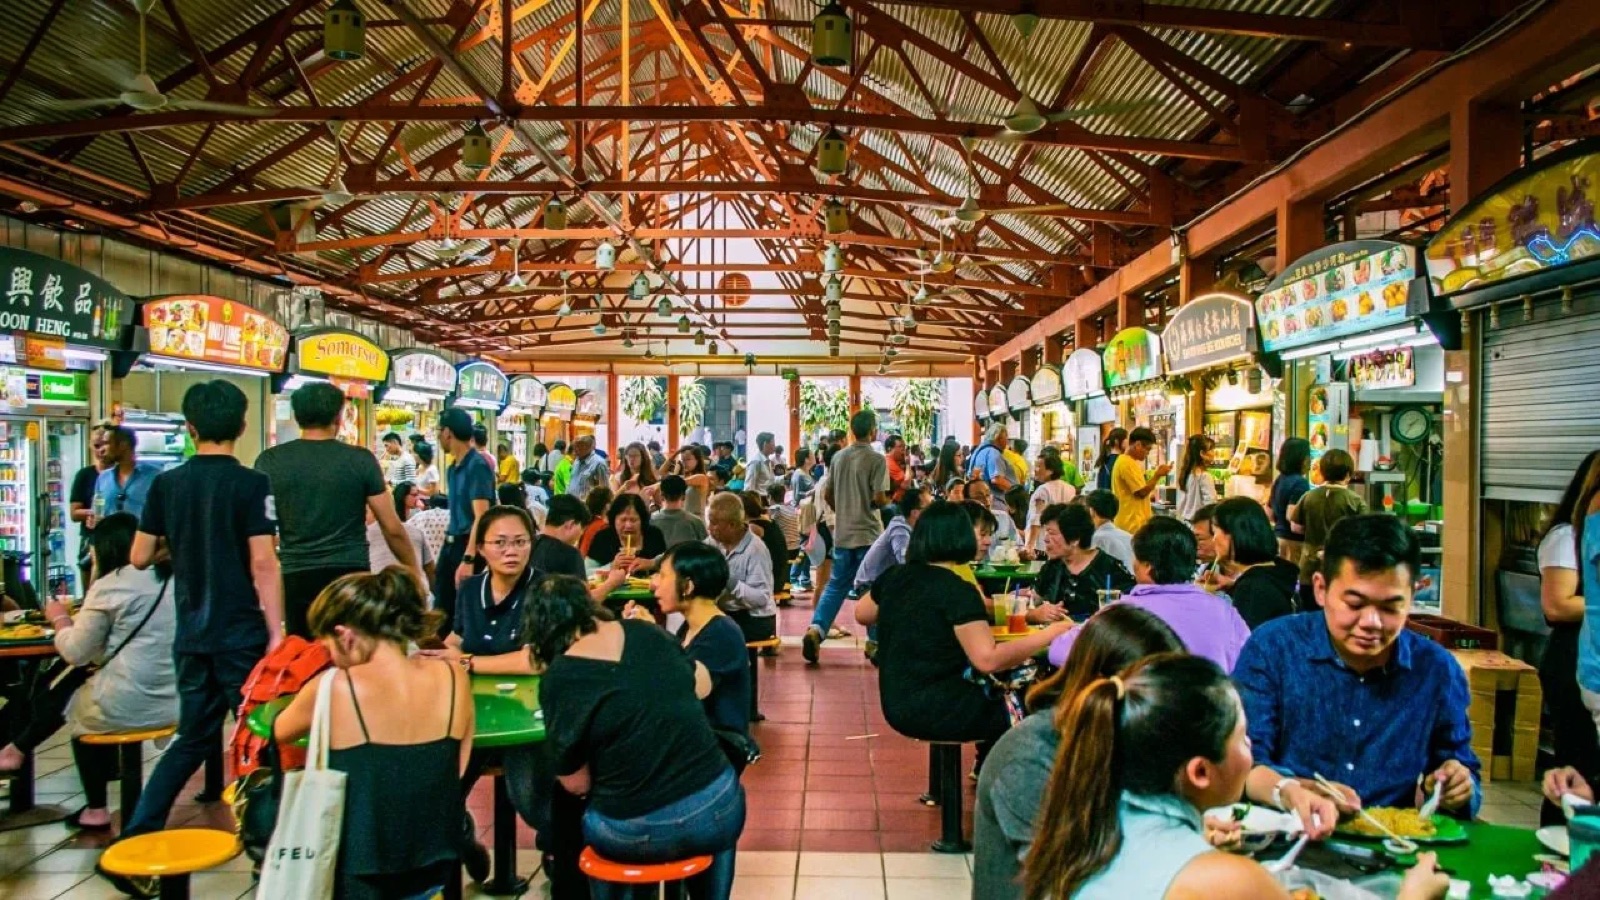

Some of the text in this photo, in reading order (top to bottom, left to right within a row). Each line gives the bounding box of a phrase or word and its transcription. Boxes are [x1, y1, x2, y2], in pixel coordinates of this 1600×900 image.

[6, 266, 92, 315] 興飲品
[36, 318, 71, 336] HENG
[315, 338, 379, 368] Somerset
